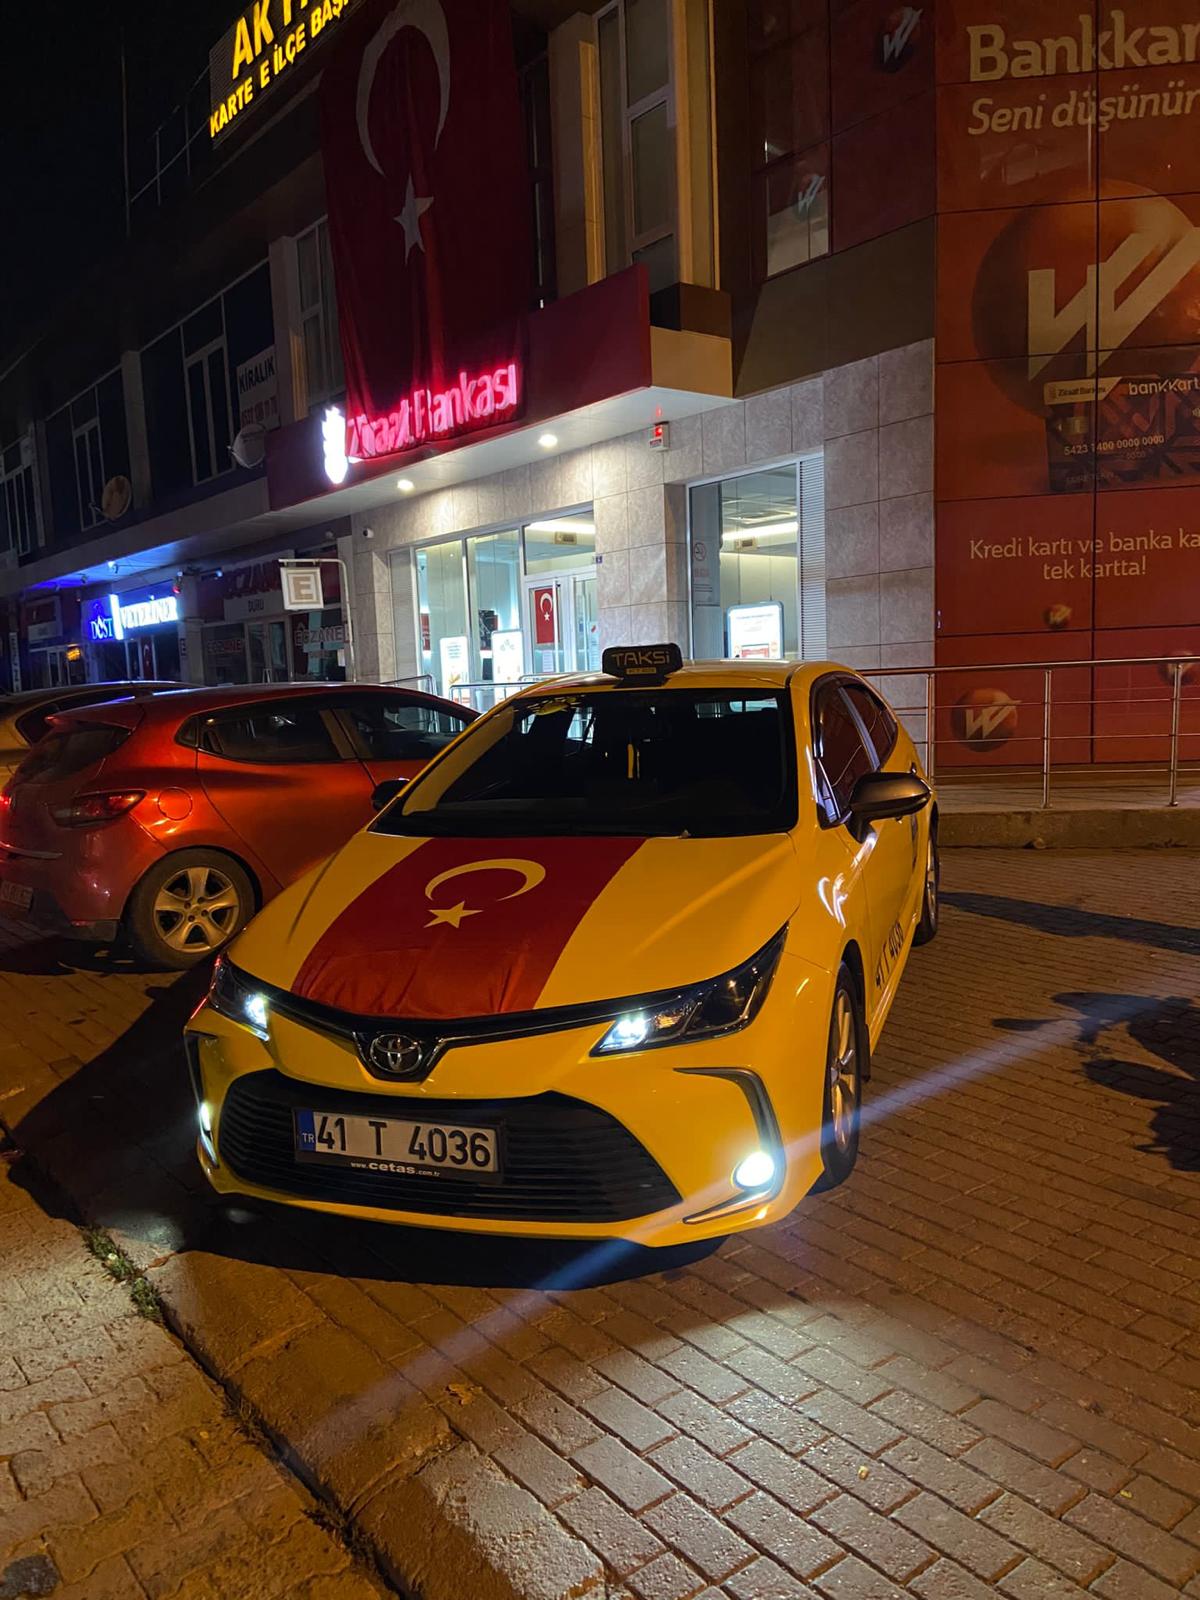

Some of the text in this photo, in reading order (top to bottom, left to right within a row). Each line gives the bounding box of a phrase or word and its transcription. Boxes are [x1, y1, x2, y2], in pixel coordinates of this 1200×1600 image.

[273, 23, 306, 75] İLÇE
[310, 0, 350, 38] BAŞ
[967, 94, 1046, 135] Seni
[970, 538, 1022, 560] Kredi
[1028, 536, 1073, 557] kartı
[1077, 540, 1104, 554] ve
[1109, 530, 1173, 553] banka
[1043, 556, 1147, 580] tek kartta!
[292, 575, 315, 601] E
[302, 1116, 491, 1168] TR 41 T 4036
